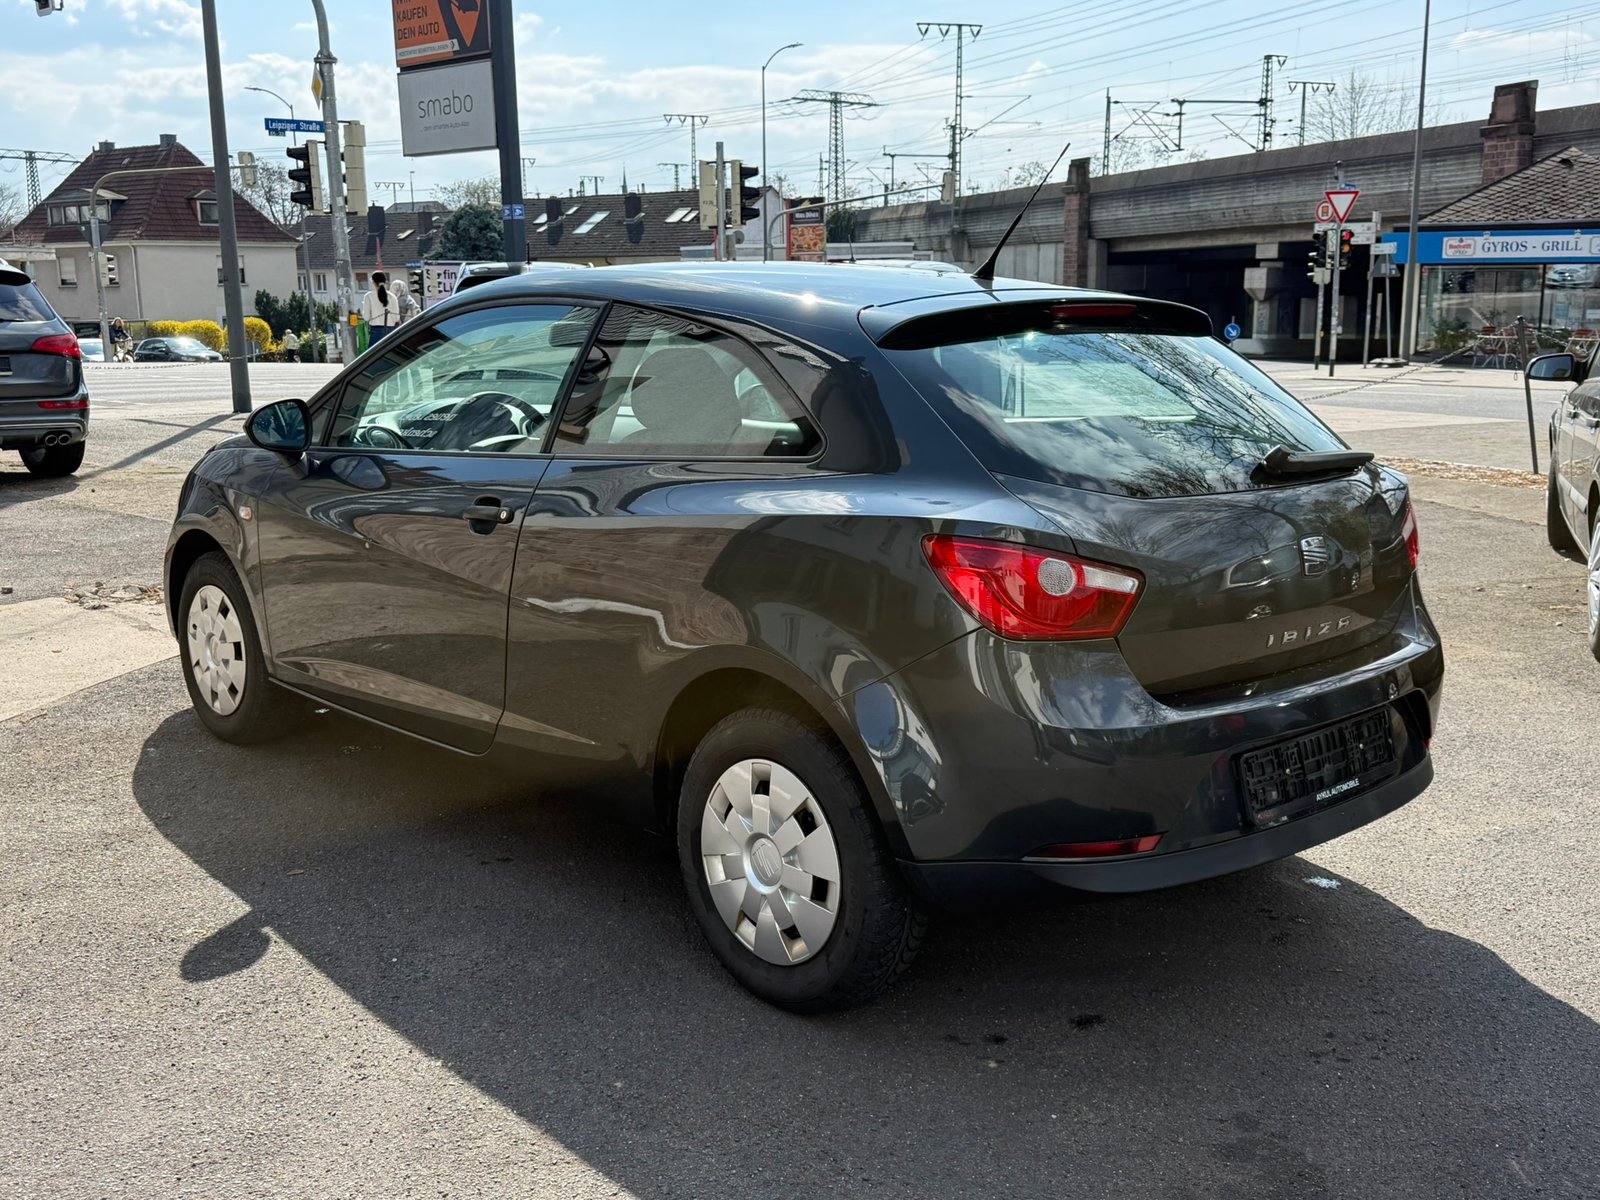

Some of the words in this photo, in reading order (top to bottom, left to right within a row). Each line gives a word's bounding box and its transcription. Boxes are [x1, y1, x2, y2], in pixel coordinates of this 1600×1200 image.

[396, 7, 428, 22] KAUFEN
[397, 26, 416, 41] DEIN
[418, 22, 439, 37] AUTO
[418, 89, 473, 118] smabo
[268, 120, 296, 131] Leipziger
[300, 122, 320, 131] Straße
[1482, 241, 1528, 253] GYROS
[1541, 239, 1583, 252] GRILL
[1266, 616, 1351, 648] IBIZA
[1332, 778, 1360, 796] AUTOMOBILE
